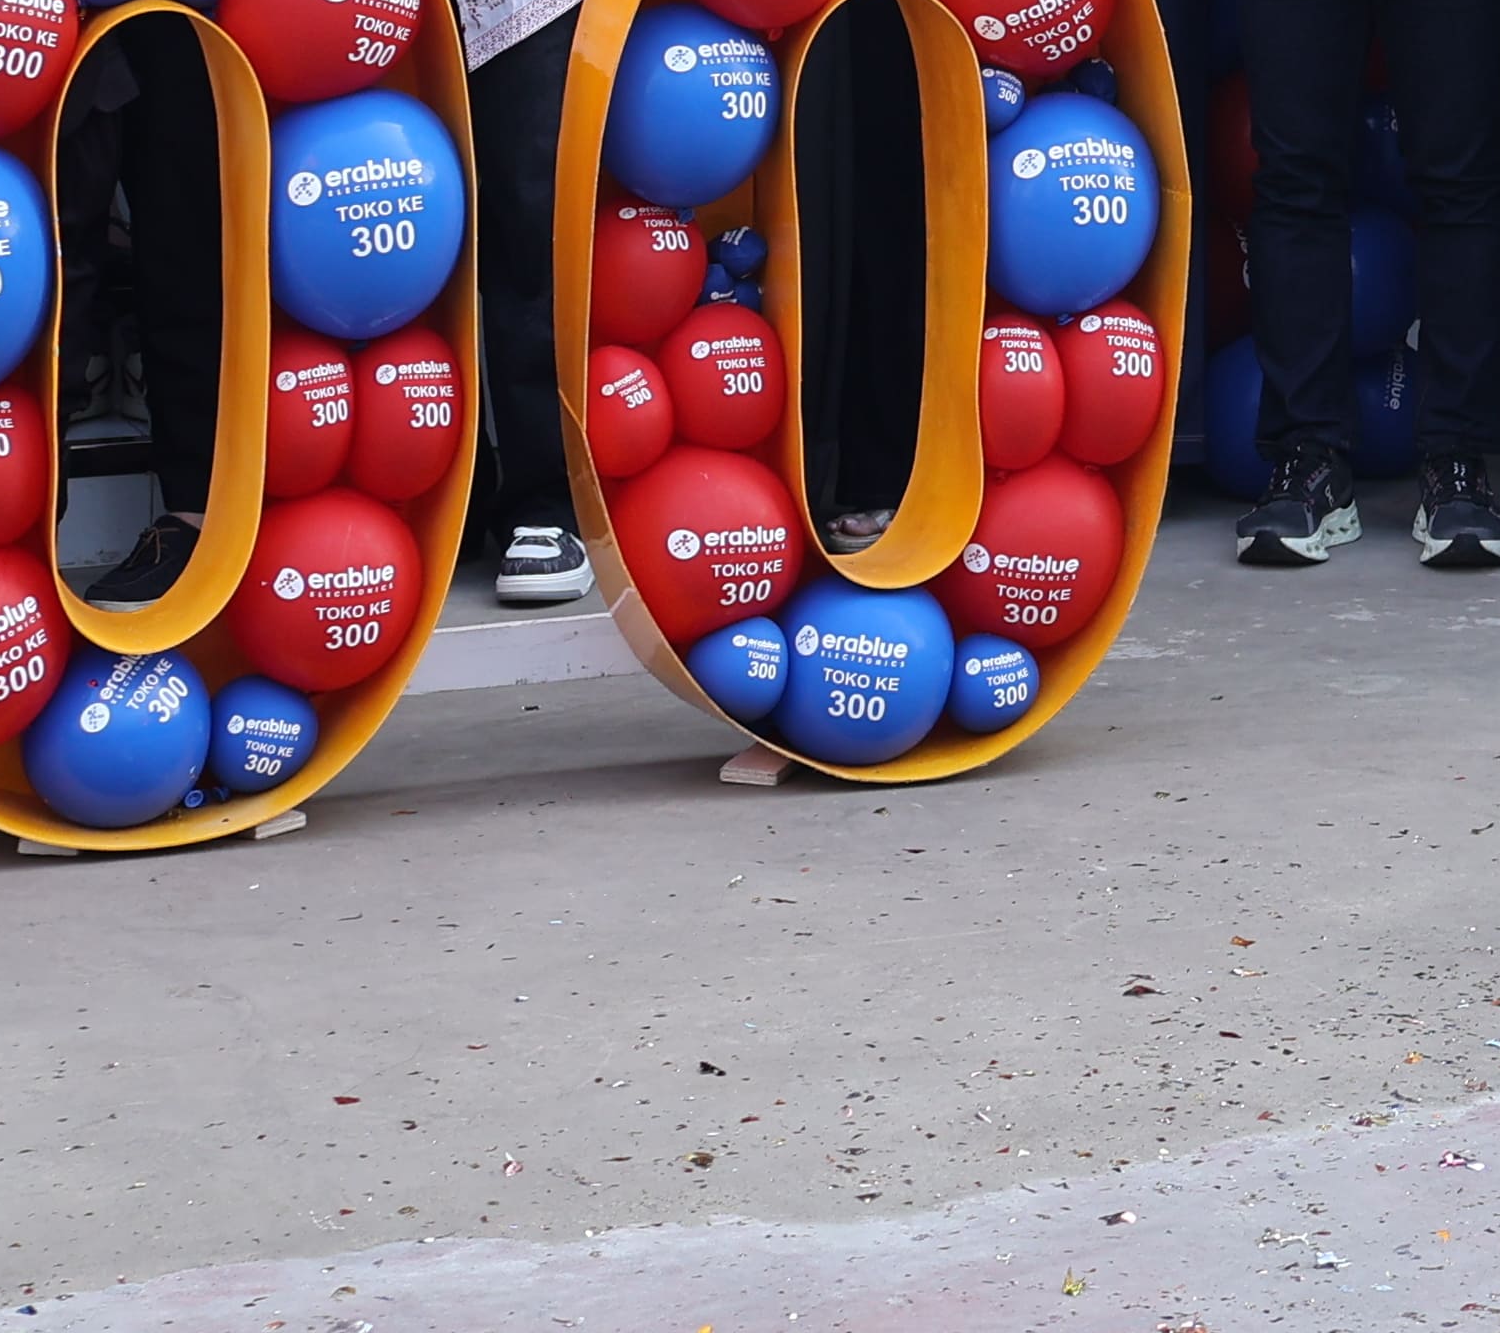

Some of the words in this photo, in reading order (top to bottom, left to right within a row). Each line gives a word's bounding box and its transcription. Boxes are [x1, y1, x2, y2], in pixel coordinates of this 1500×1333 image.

[36, 29, 58, 48] KE
[325, 159, 422, 188] erablue
[335, 201, 391, 223] TOKO
[397, 195, 424, 214] KE
[350, 221, 417, 258] 300
[820, 631, 908, 662] erablue
[822, 668, 870, 691] TOKO
[874, 676, 900, 692] KE
[828, 690, 885, 723] 300
